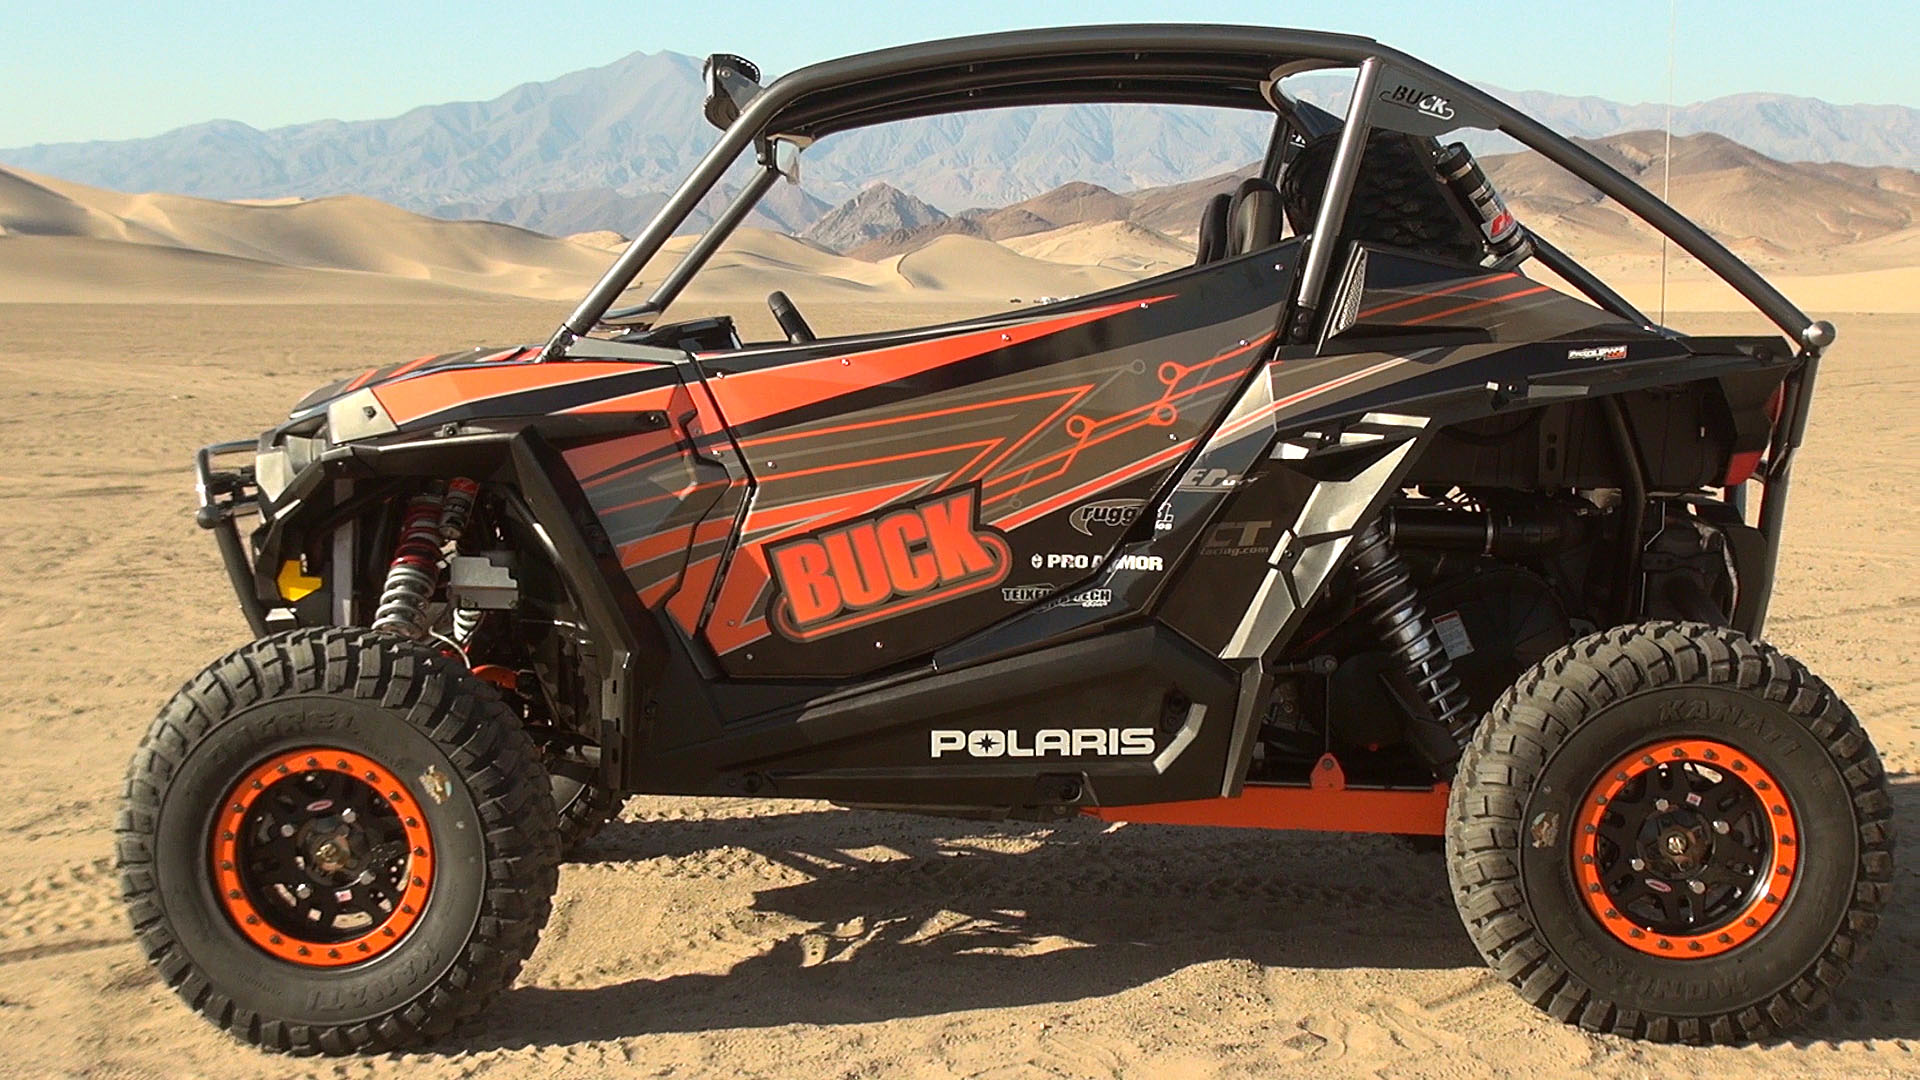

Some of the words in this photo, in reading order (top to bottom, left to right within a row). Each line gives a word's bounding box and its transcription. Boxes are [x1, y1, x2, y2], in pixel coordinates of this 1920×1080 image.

[1391, 85, 1451, 114] BUCK
[774, 492, 995, 626] BUCK
[1047, 553, 1089, 570] PRO
[1091, 554, 1164, 571] AMOR
[930, 727, 1156, 758] POLARIS
